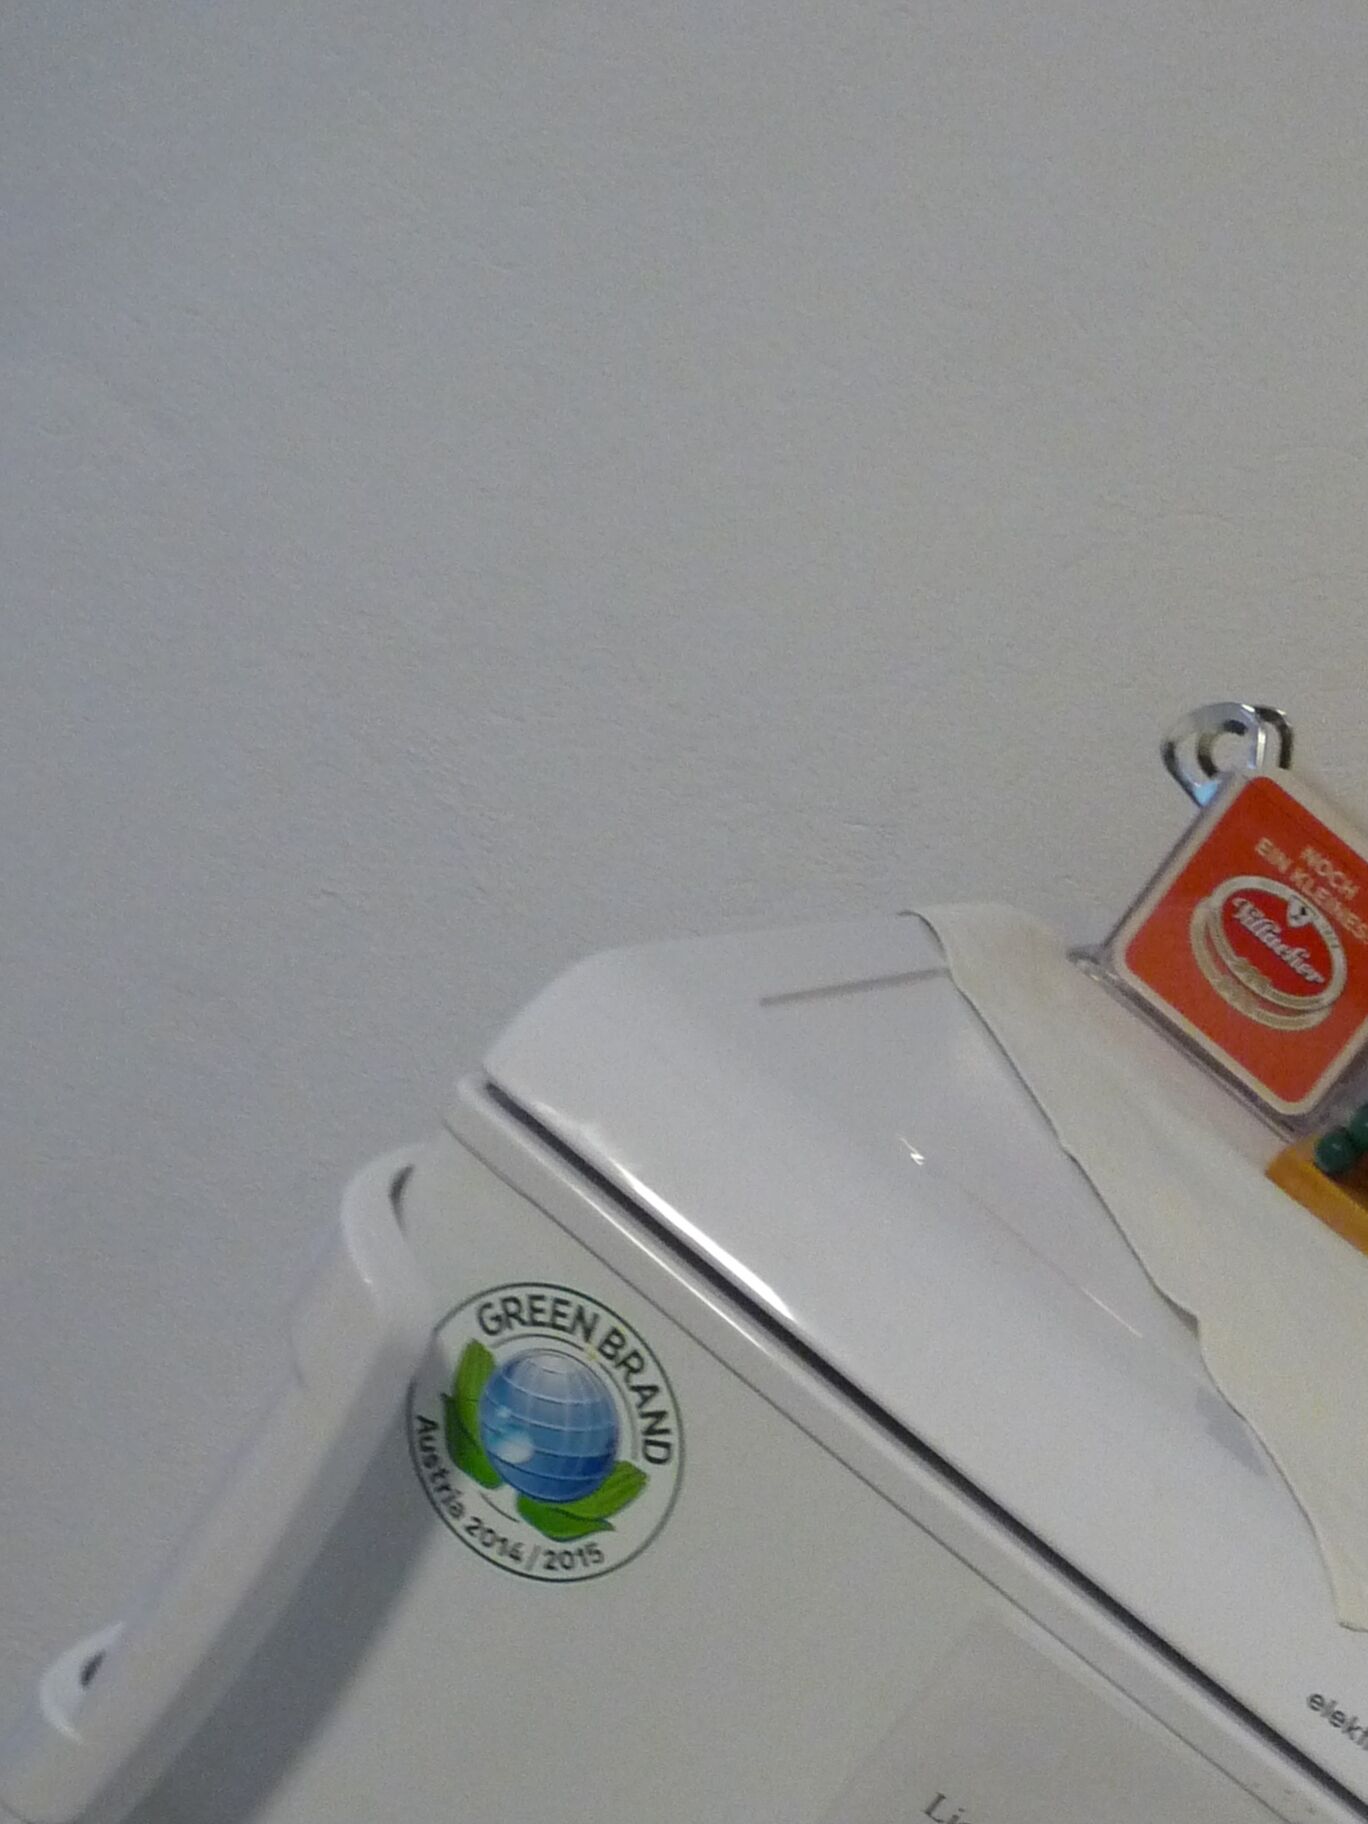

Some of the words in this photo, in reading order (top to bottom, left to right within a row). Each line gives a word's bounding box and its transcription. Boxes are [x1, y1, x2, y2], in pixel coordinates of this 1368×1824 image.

[476, 1294, 600, 1342] GREEN
[597, 1327, 672, 1466] BRAND
[416, 1415, 465, 1521] Austria
